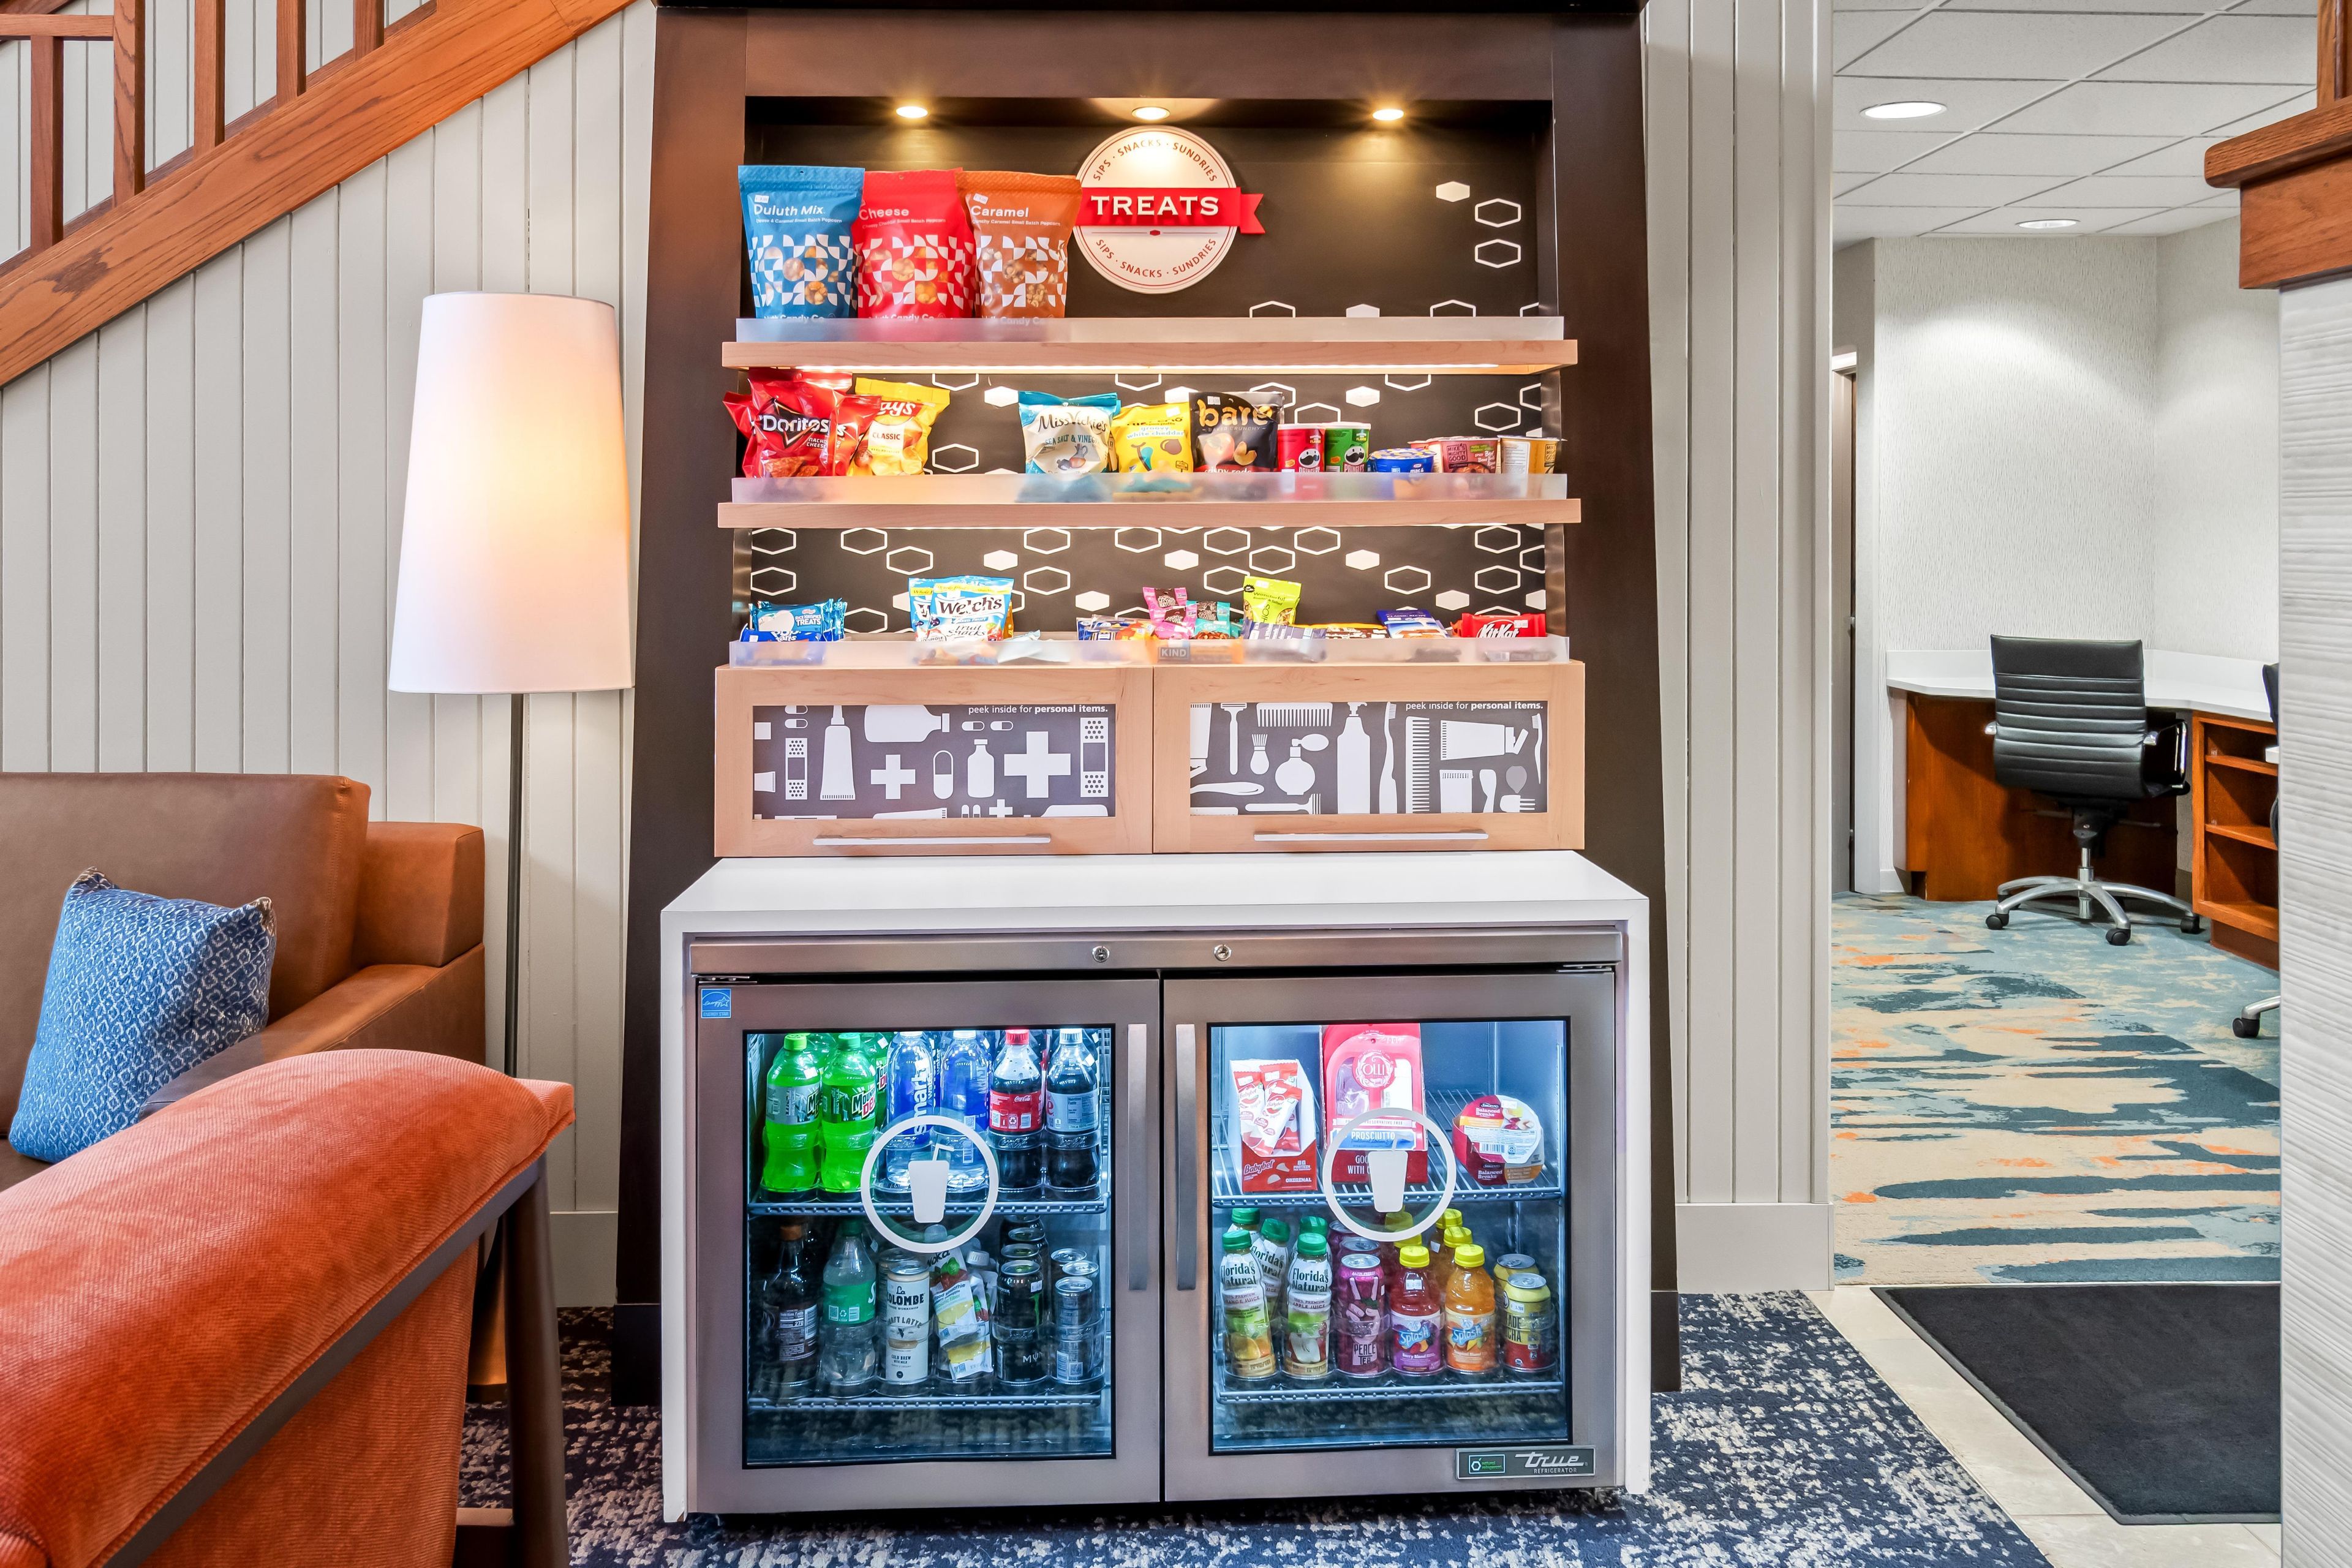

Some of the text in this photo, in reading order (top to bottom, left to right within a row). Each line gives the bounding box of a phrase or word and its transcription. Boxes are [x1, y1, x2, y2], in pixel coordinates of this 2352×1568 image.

[1093, 139, 1218, 182] SIPS SNACKS SUNDRIES
[754, 203, 824, 216] Duluth Mix
[971, 205, 1029, 217] Caramel
[1091, 195, 1219, 216] TREATS
[859, 208, 910, 221] Cheese
[1096, 238, 1216, 277] SIPS SNACKS SUNDRIES
[1197, 399, 1273, 427] bare
[763, 415, 829, 433] Doritos
[1038, 414, 1070, 432] Miss
[1058, 434, 1069, 443] SALT
[1253, 592, 1286, 601] Wonderful
[938, 597, 1003, 614] Welch's
[1161, 649, 1186, 657] KIND
[968, 705, 989, 715] peek
[1035, 704, 1076, 715] personal
[1406, 701, 1426, 711] peek
[1471, 701, 1512, 710] personal
[1362, 1063, 1385, 1076] OLLI
[1351, 1131, 1396, 1140] PROSCIUTTO
[1244, 1159, 1275, 1175] Babybel
[1348, 1165, 1365, 1174] WITH
[1262, 1264, 1281, 1278] ural
[1292, 1268, 1329, 1283] Florida's
[1223, 1276, 1257, 1286] atural
[1292, 1280, 1329, 1292] Natural
[896, 1286, 905, 1294] La
[946, 1283, 966, 1295] smoothie
[902, 1316, 923, 1329] LATTE
[1400, 1326, 1430, 1344] Splash
[1453, 1325, 1482, 1343] Splash
[1354, 1343, 1376, 1355] PEACE
